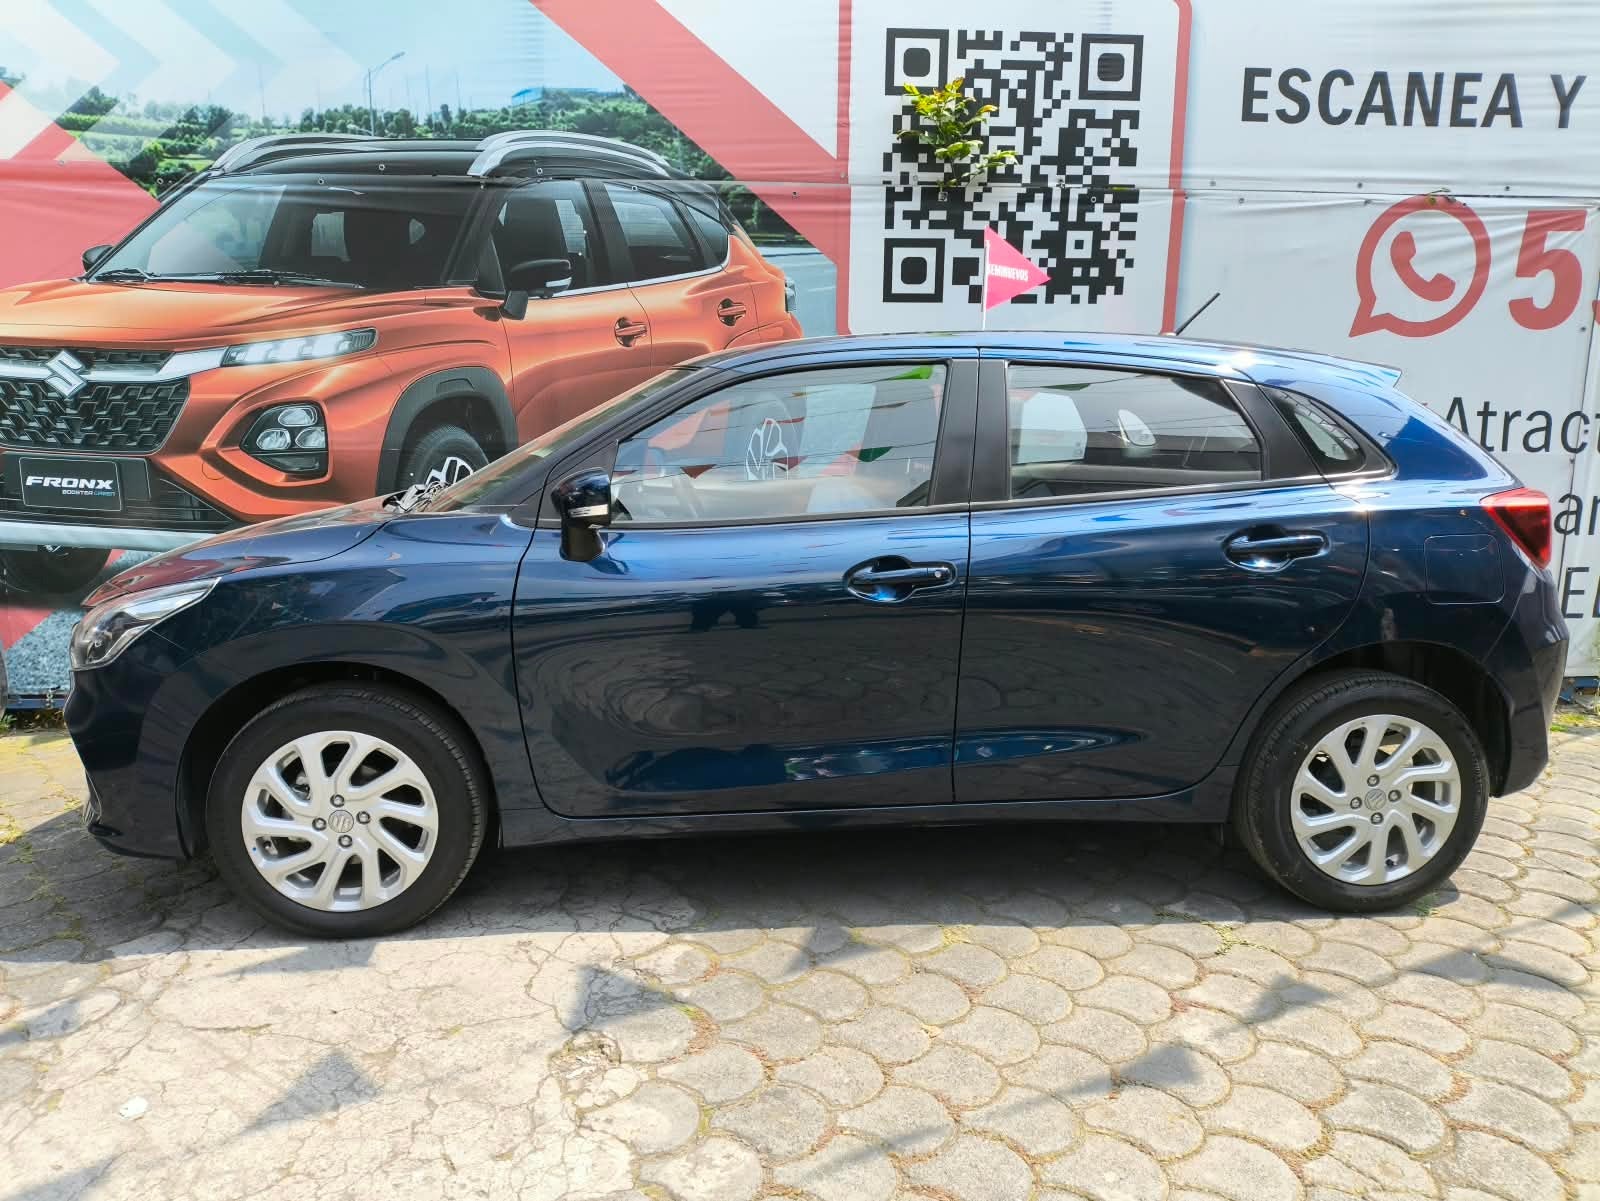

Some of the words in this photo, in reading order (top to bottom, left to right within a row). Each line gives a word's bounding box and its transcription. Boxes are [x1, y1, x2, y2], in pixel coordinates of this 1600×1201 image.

[1241, 66, 1523, 129] ESCANEA
[1550, 73, 1588, 129] Y
[1508, 209, 1600, 331] 5
[1446, 396, 1600, 454] Atrac
[25, 475, 114, 490] FRONX
